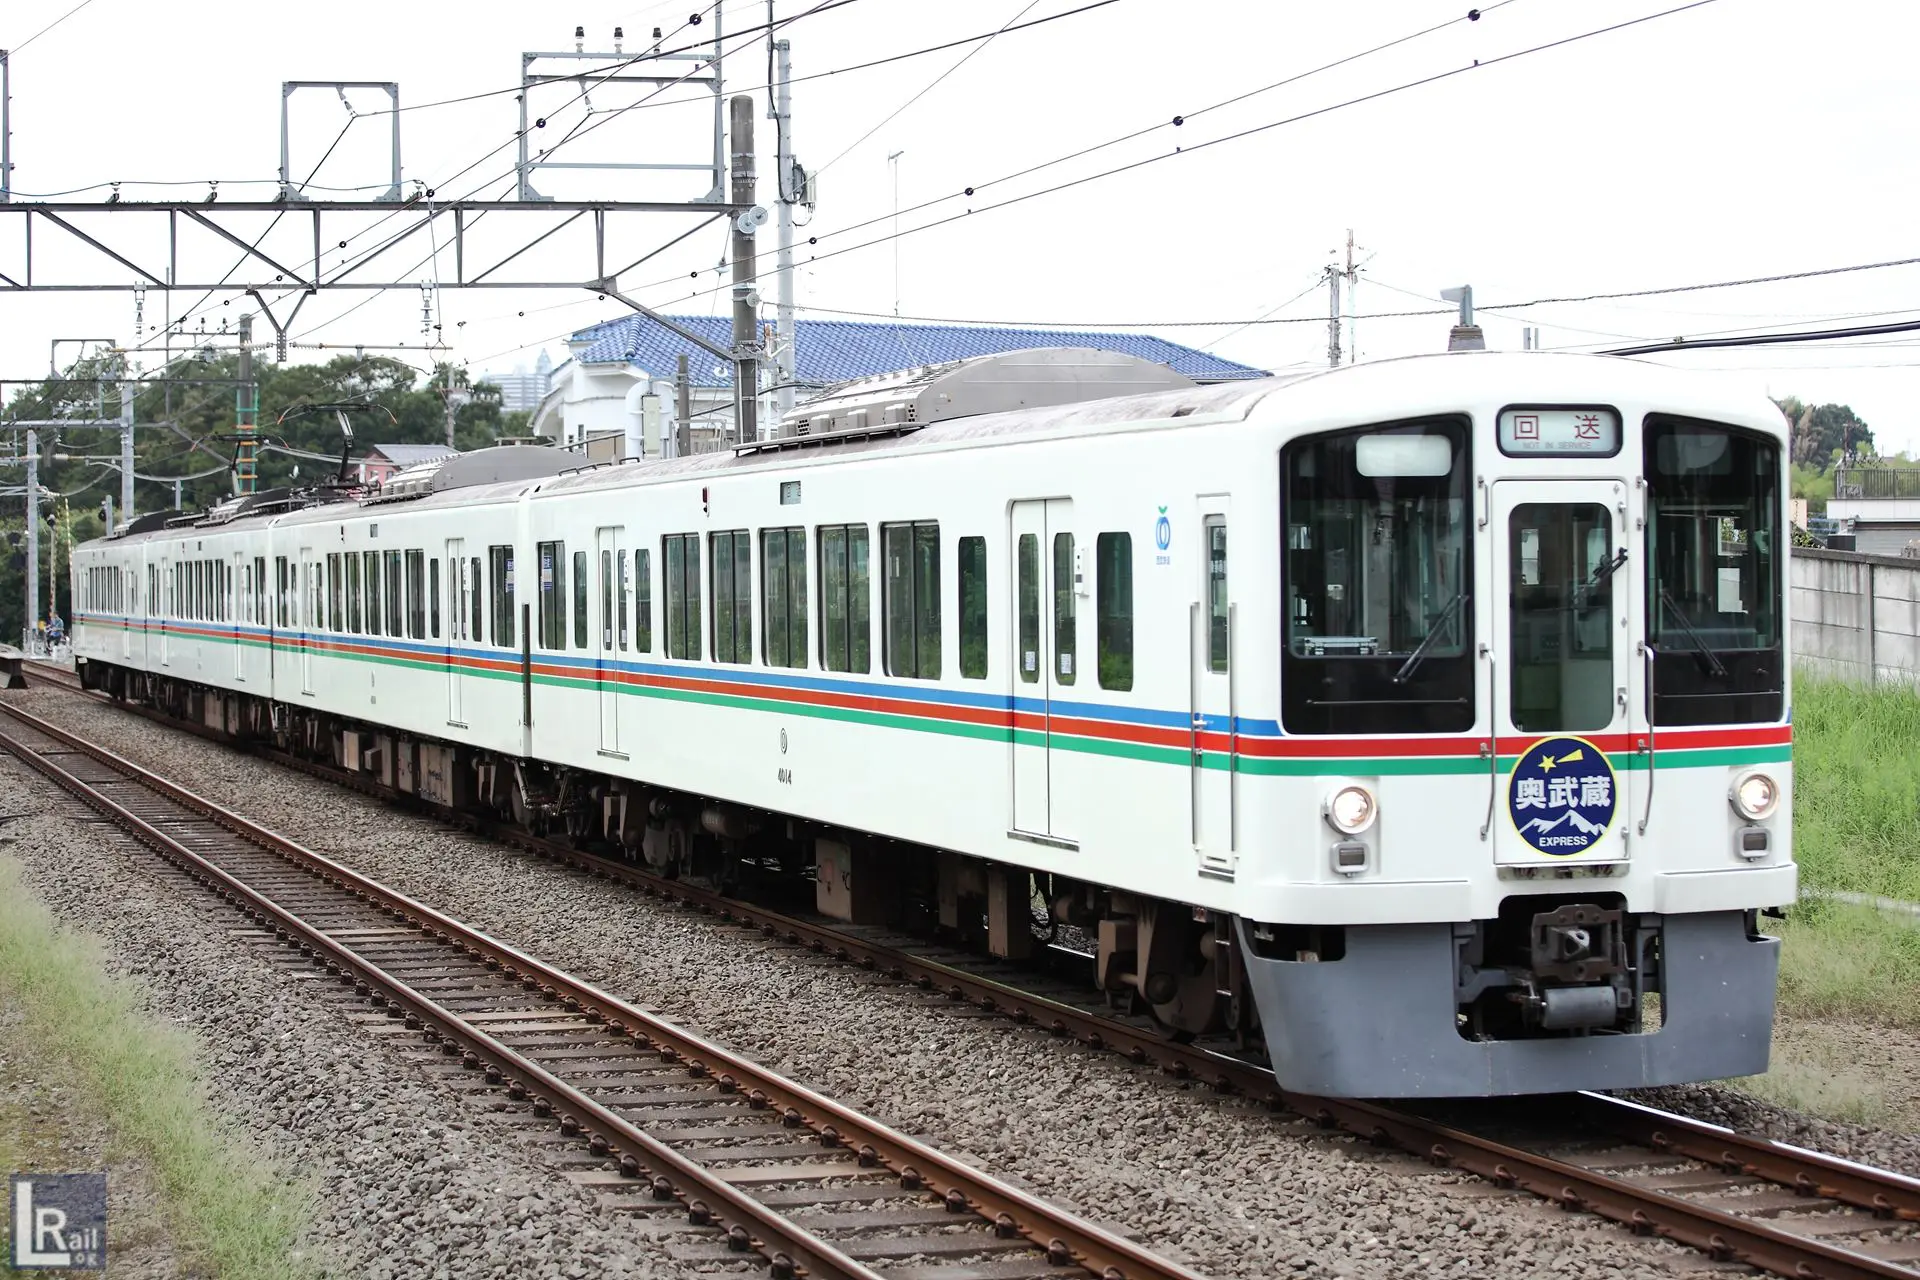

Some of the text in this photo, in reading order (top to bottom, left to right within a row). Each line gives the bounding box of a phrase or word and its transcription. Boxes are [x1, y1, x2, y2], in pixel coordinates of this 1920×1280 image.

[1522, 441, 1592, 449] NOT IN SERVICE
[778, 767, 792, 784] 4014
[1515, 775, 1611, 810] 奥武蔵
[1539, 835, 1588, 847] EXPRESS
